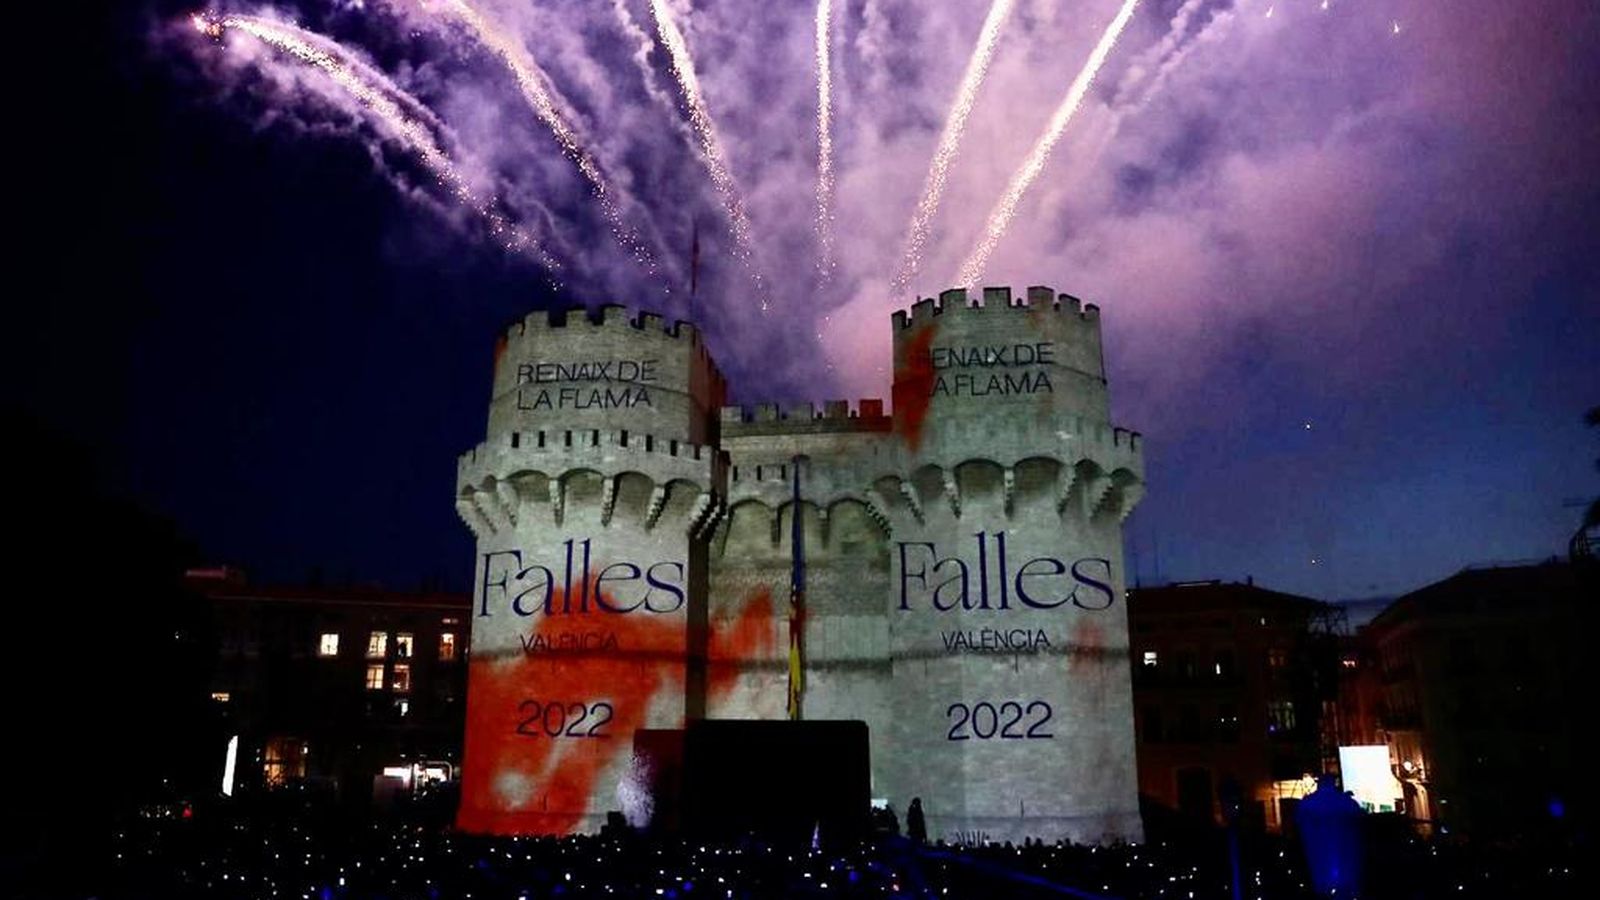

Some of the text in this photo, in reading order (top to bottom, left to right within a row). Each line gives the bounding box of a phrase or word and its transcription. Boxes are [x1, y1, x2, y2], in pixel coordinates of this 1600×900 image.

[516, 360, 659, 383] RENAIX DE
[914, 343, 1054, 369] ENAIX DE
[517, 388, 652, 410] LA FLAMA
[955, 372, 1053, 396] FLAMA
[478, 538, 685, 617] Falles
[897, 531, 1115, 611] Falles
[517, 700, 613, 737] 2022
[947, 701, 1053, 741] 2022
